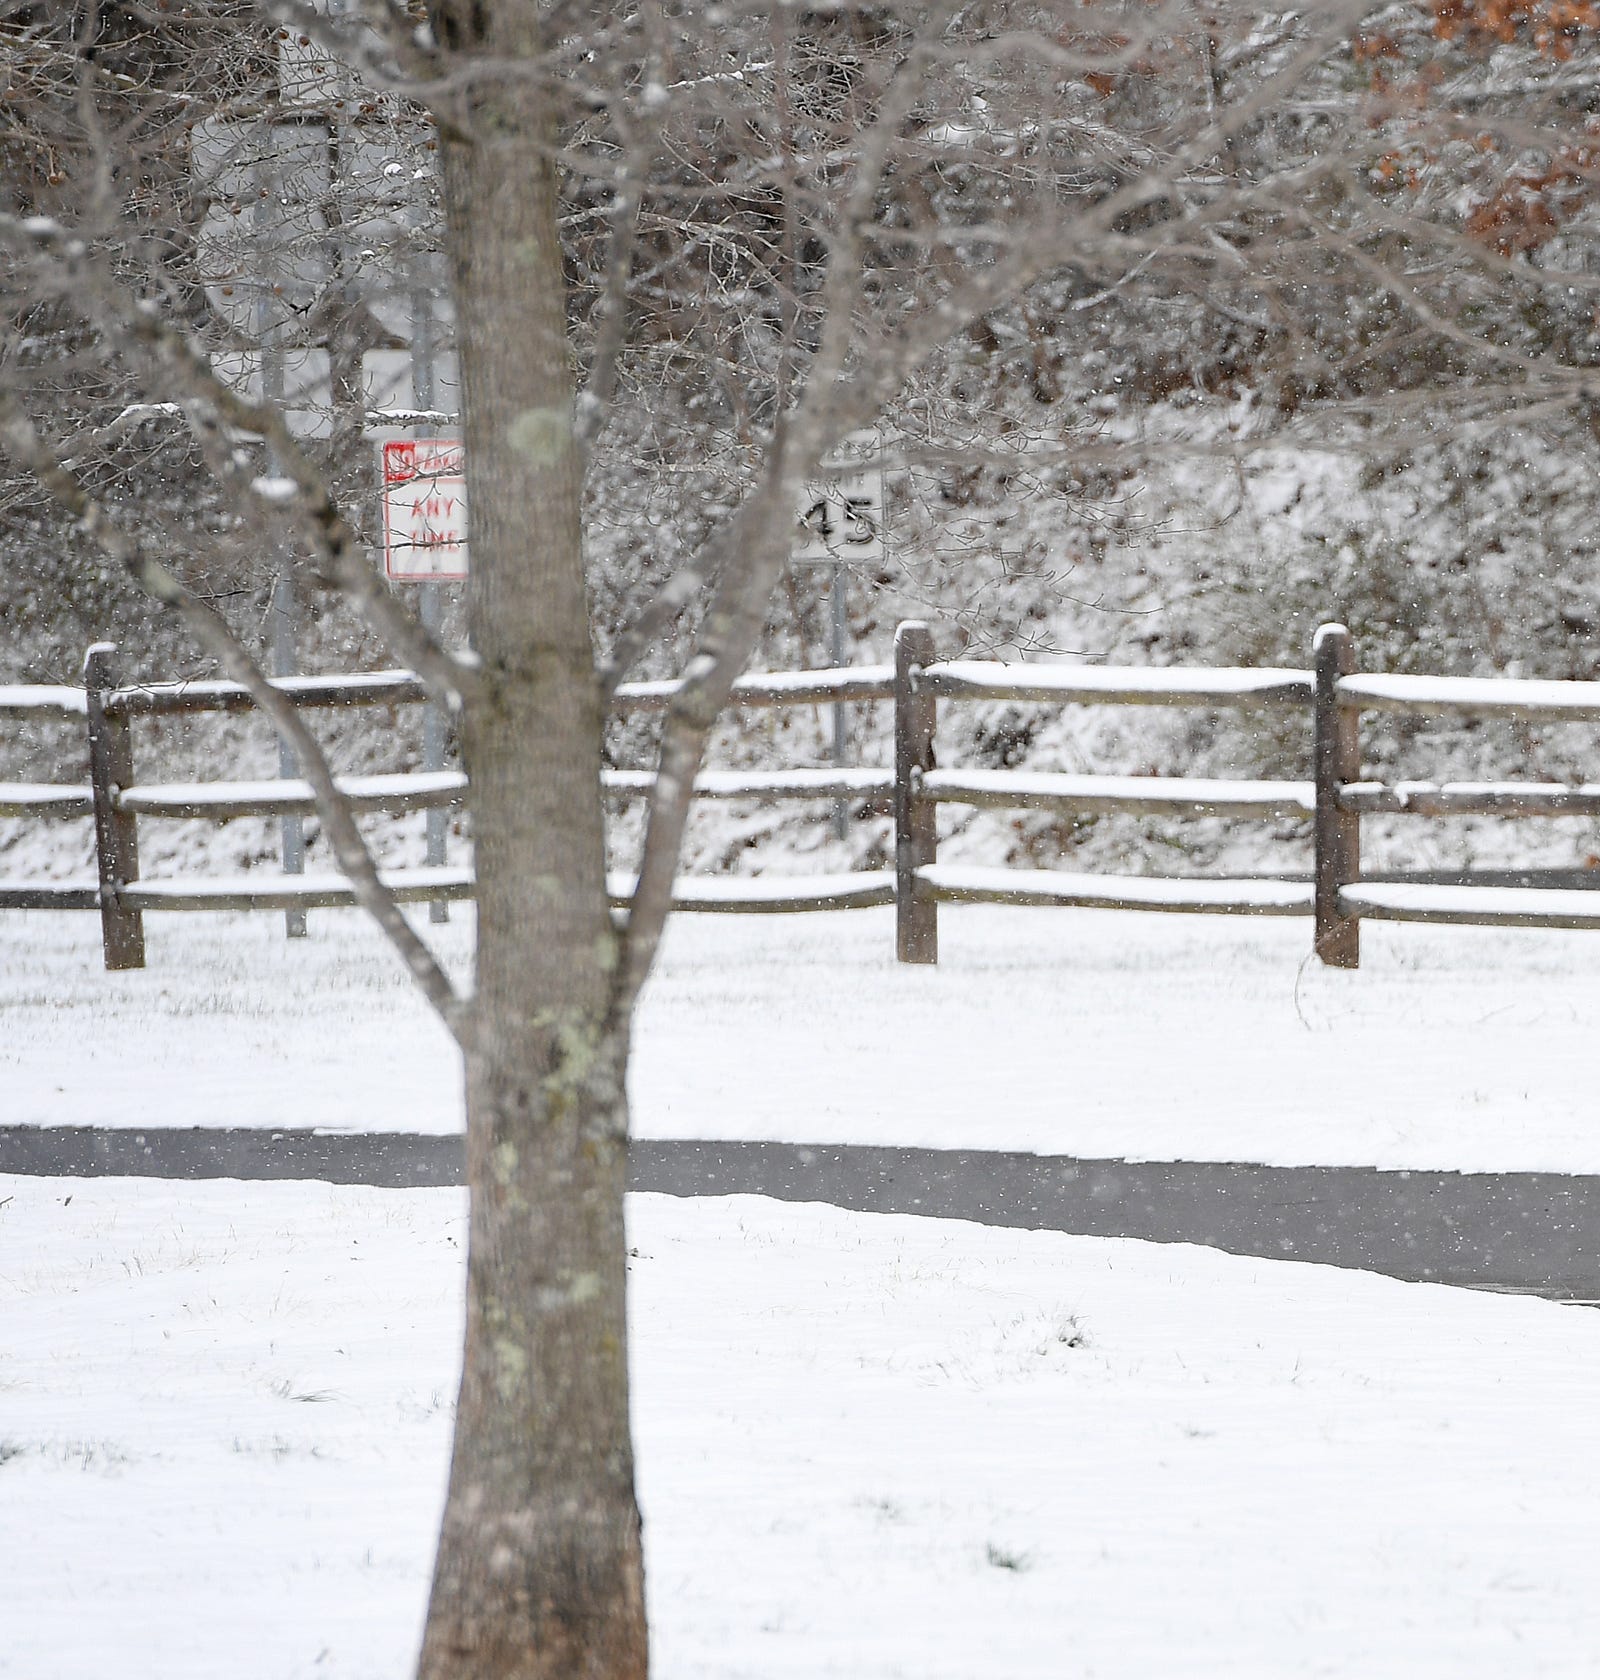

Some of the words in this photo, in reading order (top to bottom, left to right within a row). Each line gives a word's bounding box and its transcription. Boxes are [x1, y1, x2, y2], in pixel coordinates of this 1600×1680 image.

[411, 497, 456, 519] ANY
[800, 500, 876, 545] 45
[409, 529, 461, 554] TIME
